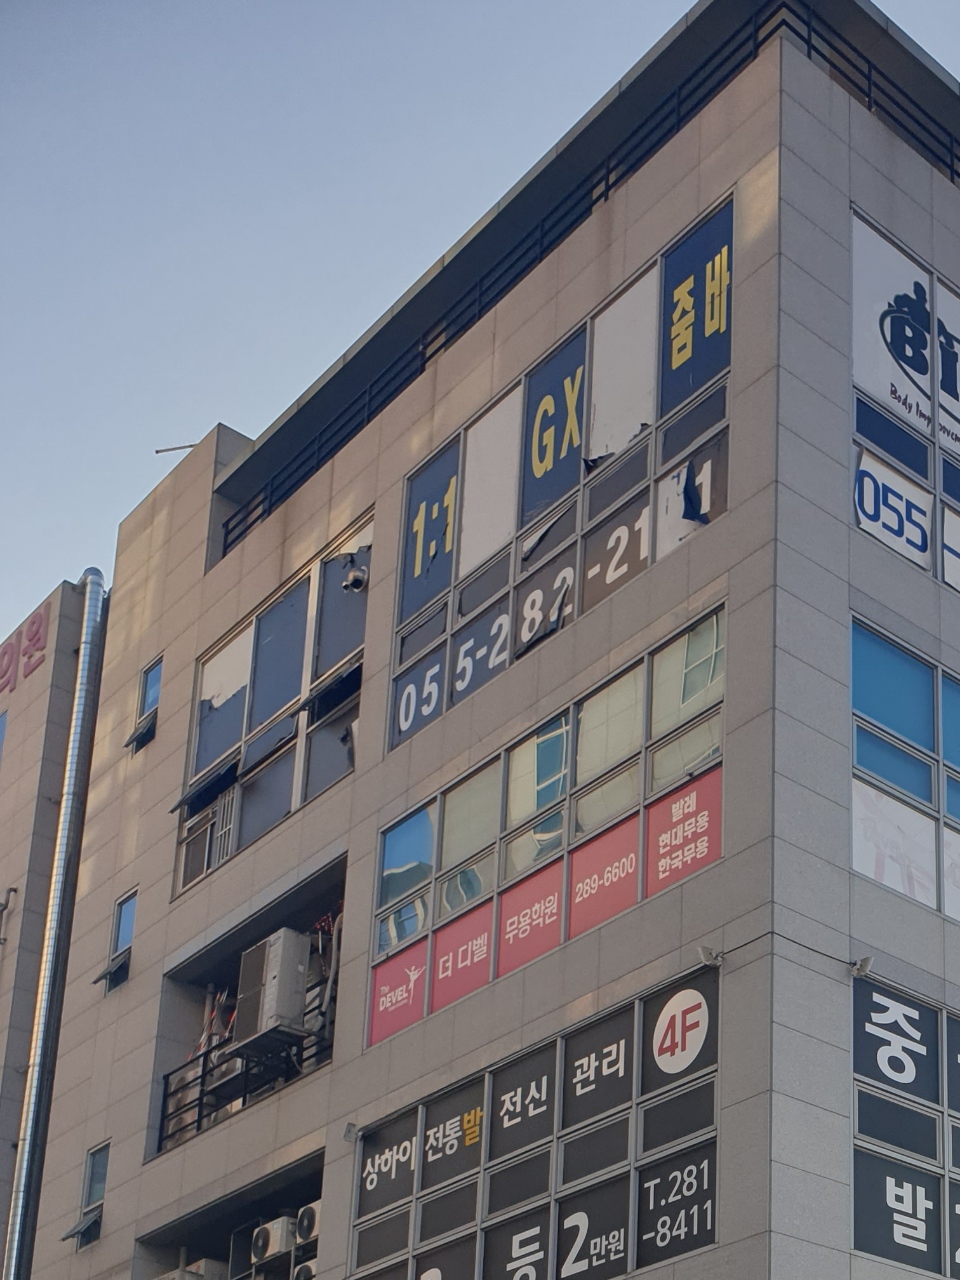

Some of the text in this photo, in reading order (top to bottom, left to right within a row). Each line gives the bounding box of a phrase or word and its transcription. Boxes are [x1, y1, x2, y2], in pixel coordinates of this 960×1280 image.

[670, 245, 730, 370] 줌바
[531, 365, 584, 479] GX
[412, 474, 457, 579] 1:1
[400, 459, 712, 731] 055-282-211
[658, 810, 709, 854] 현대무용
[671, 791, 697, 823] 발레
[575, 853, 636, 904] 289-6600
[658, 836, 709, 880] 한국무용
[505, 892, 558, 944] 무용학원
[438, 932, 488, 980] 더 디벨
[380, 985, 408, 1011] DEVEL
[657, 1001, 702, 1058] 4F
[362, 1135, 416, 1190] 상하이
[500, 1075, 548, 1128] 전신
[572, 1038, 627, 1097] 관리
[644, 1158, 709, 1211] T.281
[642, 1200, 713, 1247] -8411
[886, 1175, 933, 1251] 발
[560, 1211, 626, 1279] 2만원
